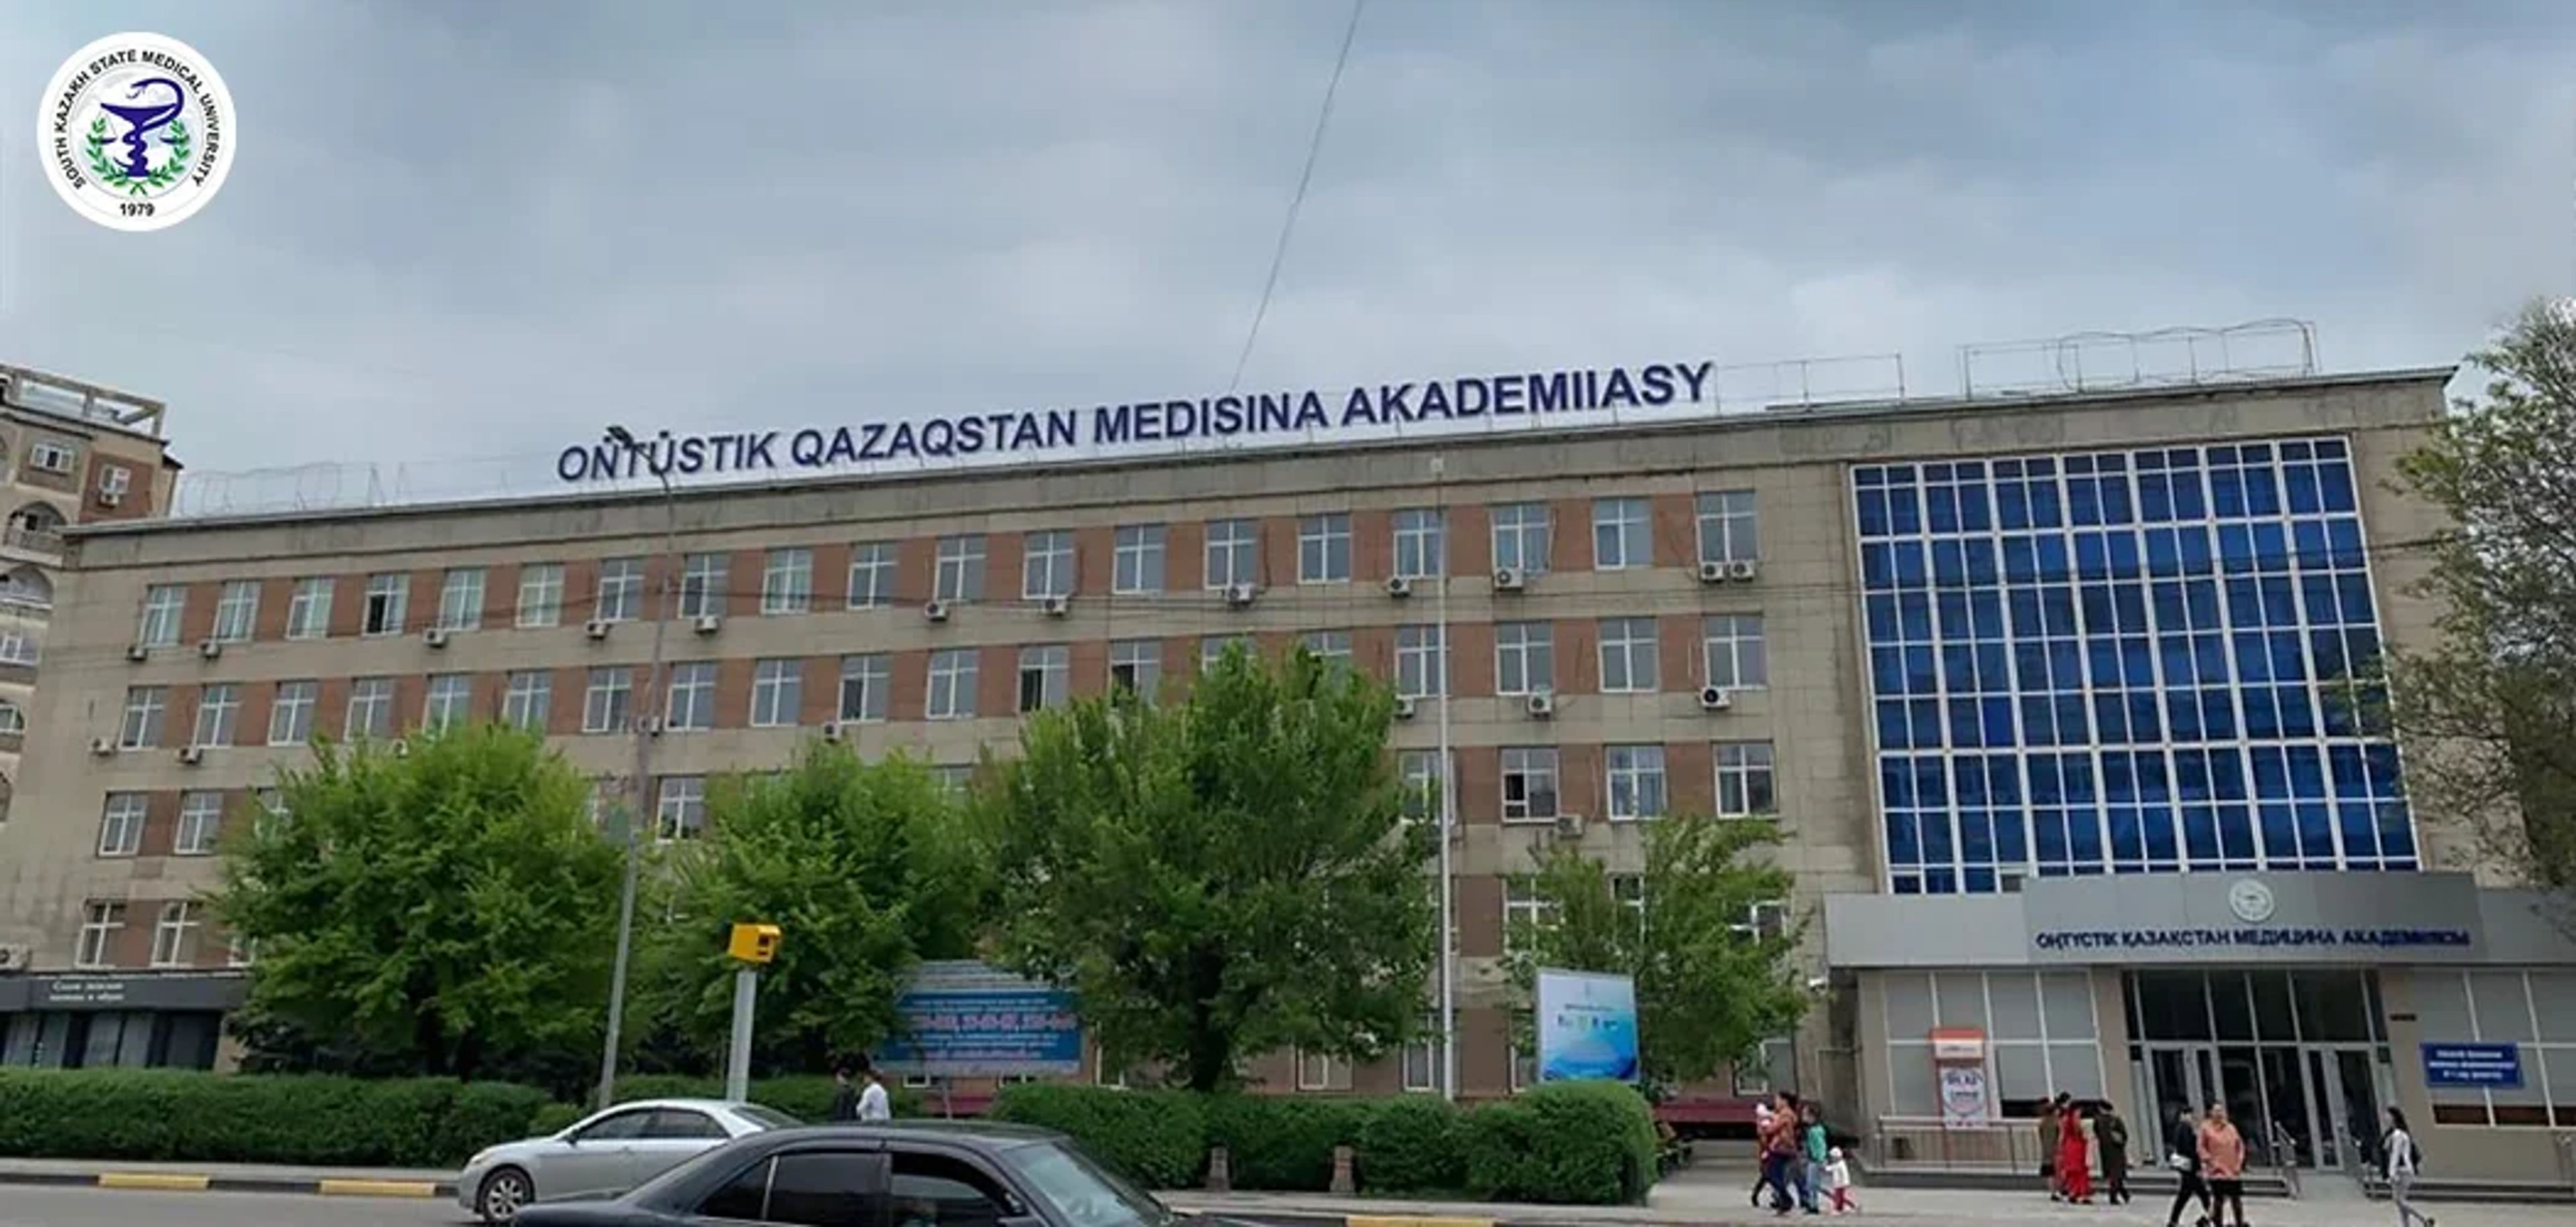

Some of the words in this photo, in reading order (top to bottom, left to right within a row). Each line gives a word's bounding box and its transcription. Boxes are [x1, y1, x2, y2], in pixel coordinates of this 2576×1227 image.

[792, 410, 1075, 466] QAZAQSTAN
[1094, 392, 1328, 443] MEDISINA
[1343, 362, 1713, 427] AKADEMIIASY
